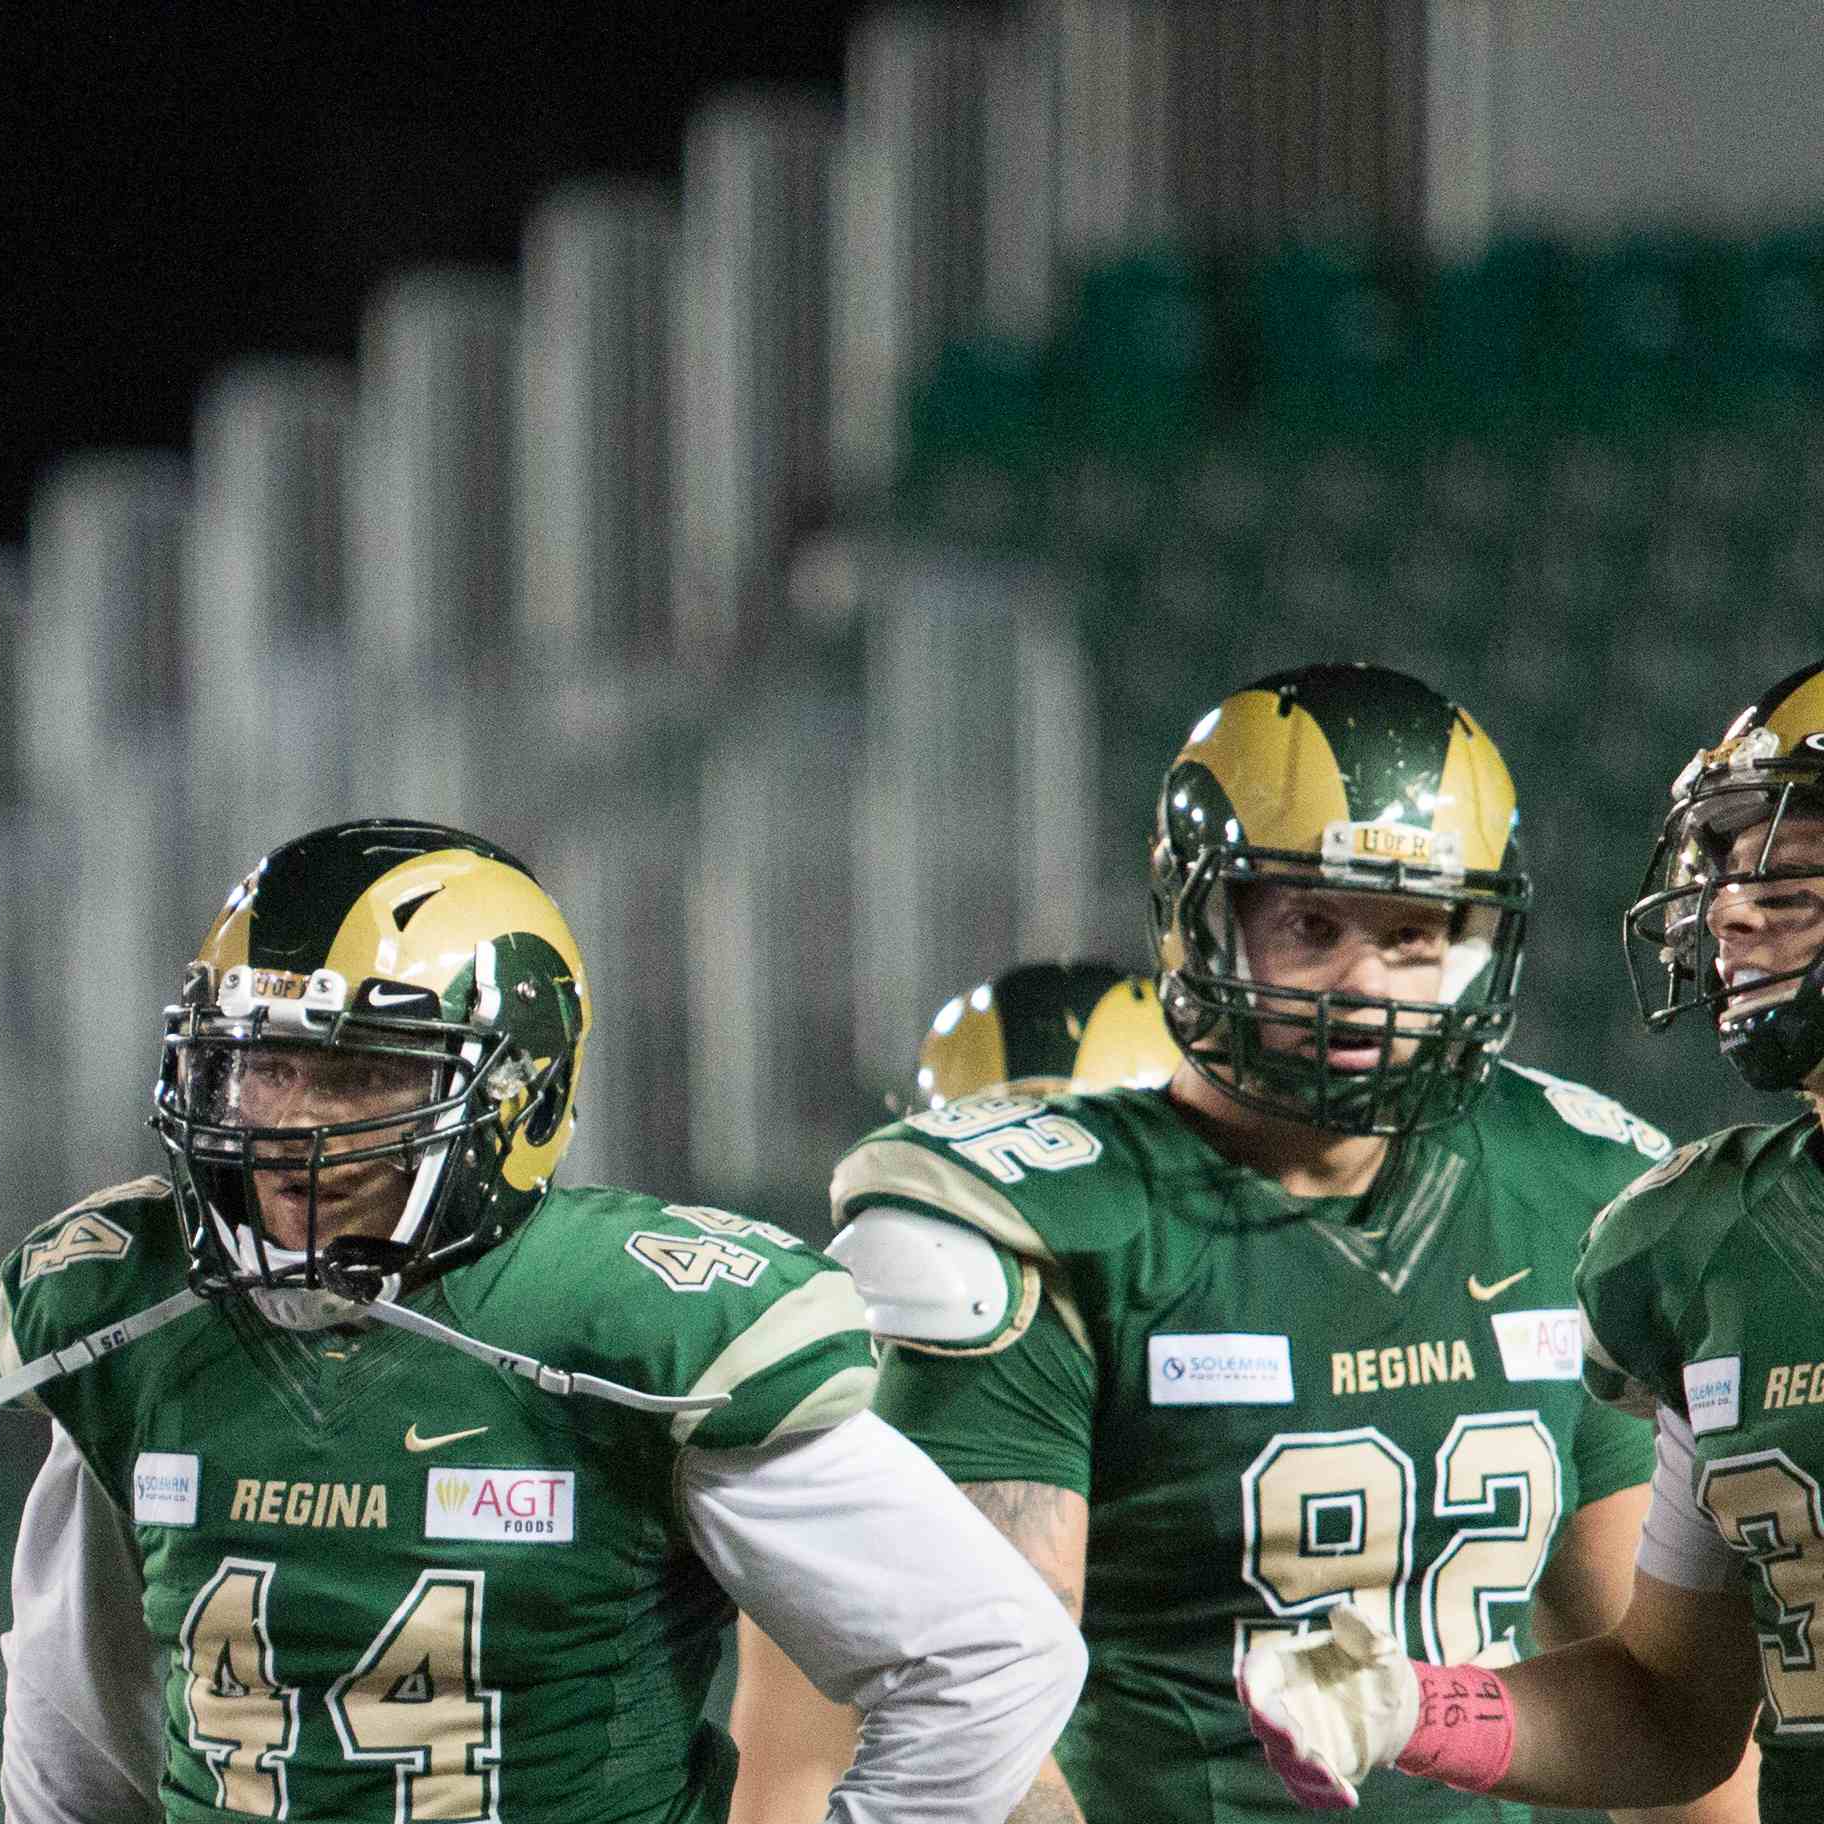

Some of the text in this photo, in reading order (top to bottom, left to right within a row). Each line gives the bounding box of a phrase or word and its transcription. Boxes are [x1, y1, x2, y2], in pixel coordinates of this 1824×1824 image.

[1331, 1340, 1476, 1396] REGINA
[229, 1478, 388, 1529] REGINA
[471, 1479, 566, 1517] AGT
[504, 1520, 554, 1534] FOODS
[1233, 1410, 1562, 1670] 92
